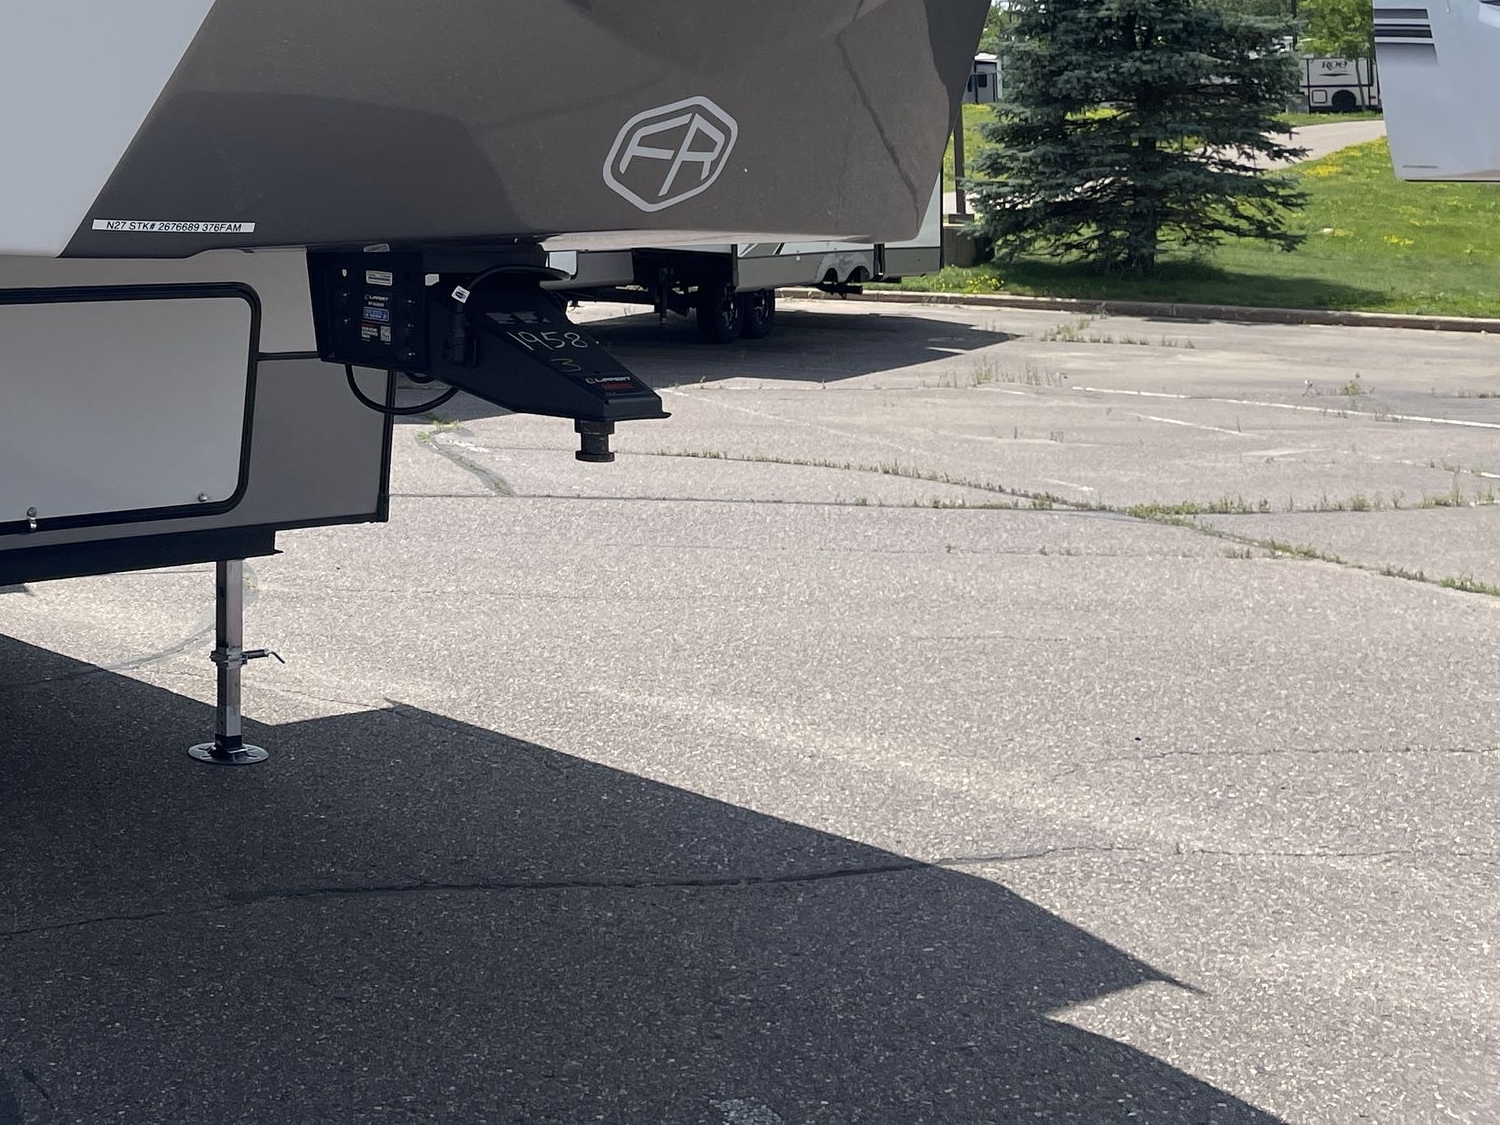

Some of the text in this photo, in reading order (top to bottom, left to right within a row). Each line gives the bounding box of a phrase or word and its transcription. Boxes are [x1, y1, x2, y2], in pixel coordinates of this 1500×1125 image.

[106, 221, 242, 232] N27 STK# 2676689 376FAM
[506, 331, 589, 351] 1958
